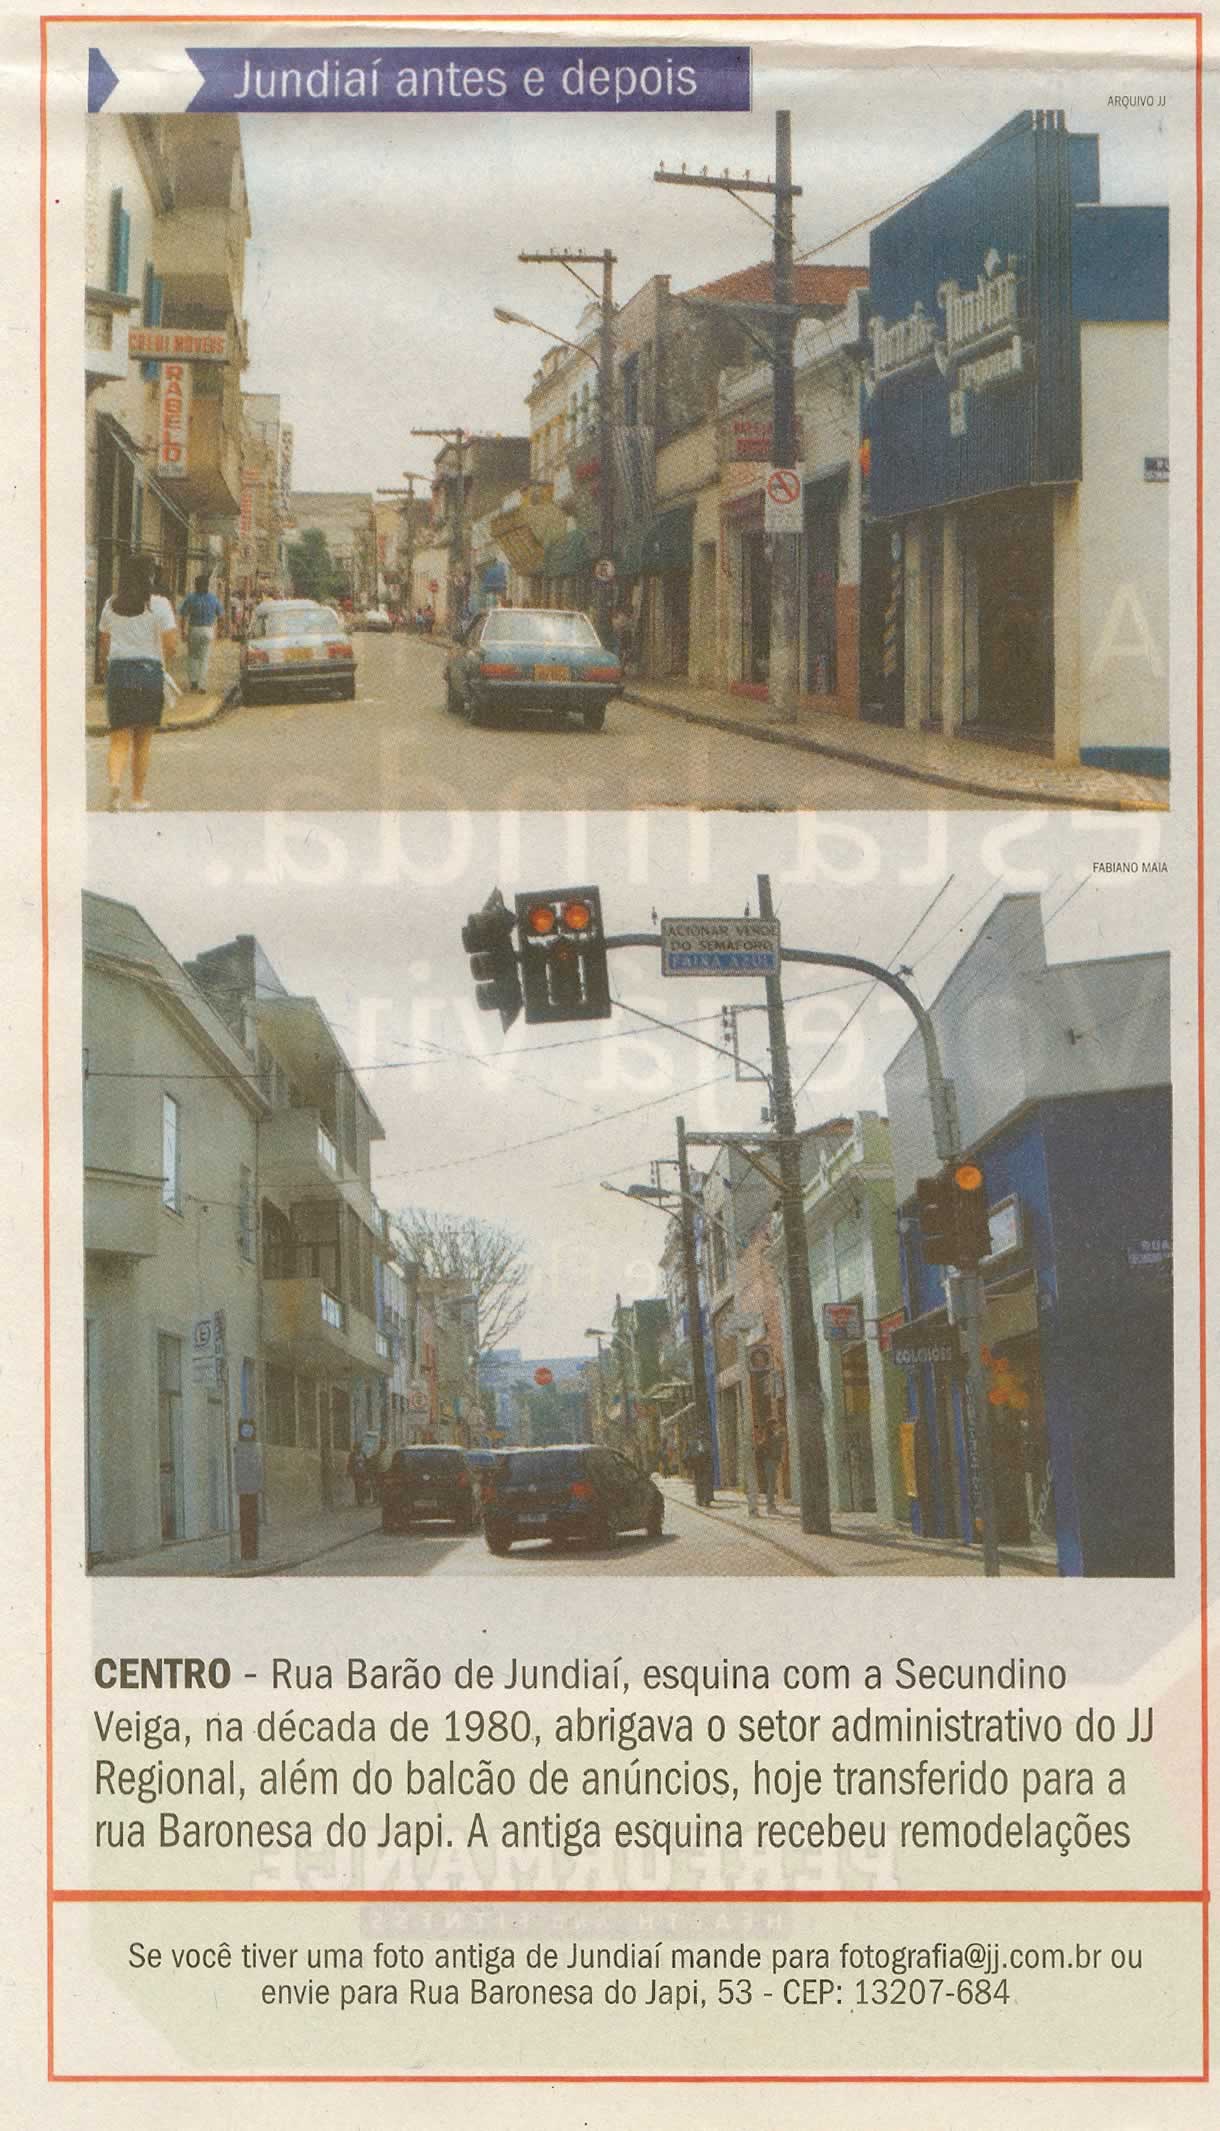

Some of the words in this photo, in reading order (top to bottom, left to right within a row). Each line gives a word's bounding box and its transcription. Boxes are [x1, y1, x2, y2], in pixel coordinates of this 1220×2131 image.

[233, 58, 381, 98] Jundiaí
[397, 62, 506, 97] antes
[523, 68, 545, 97] e
[562, 58, 697, 104] depois
[1107, 95, 1153, 108] ARQUIVO
[1157, 95, 1166, 107] JJ
[1092, 862, 1138, 874] FABIANO
[1141, 862, 1168, 874] MAIA
[670, 941, 692, 951] DO
[95, 1658, 230, 1689] CENTRO
[273, 1659, 332, 1690] Rua
[349, 1658, 441, 1690] Barão
[455, 1659, 494, 1689] de
[505, 1657, 629, 1695] Jundiaí,
[644, 1659, 769, 1697] esquina
[784, 1665, 850, 1690] com
[865, 1666, 882, 1690] a
[896, 1658, 1066, 1690] Secundino
[94, 1711, 191, 1750] Veiga,
[207, 1717, 243, 1743] na
[257, 1709, 376, 1743] década
[391, 1710, 429, 1743] de
[446, 1710, 541, 1748] 1980,
[556, 1708, 692, 1750] abrigava
[708, 1716, 726, 1743] o
[739, 1710, 821, 1743] setor
[832, 1708, 1062, 1743] administrativo
[1076, 1708, 1115, 1743] do
[1127, 1708, 1153, 1743] JJ
[97, 1760, 245, 1803] Regional,
[260, 1759, 337, 1795] além
[353, 1760, 392, 1795] do
[407, 1760, 515, 1795] balcão
[530, 1760, 568, 1795] de
[583, 1758, 738, 1801] anúncios,
[754, 1760, 822, 1803] hoje
[834, 1760, 1008, 1795] transferido
[1023, 1768, 1094, 1803] para
[1109, 1769, 1125, 1795] a
[96, 1820, 145, 1848] rua
[160, 1813, 312, 1848] Baronesa
[326, 1813, 366, 1848] do
[378, 1813, 453, 1856] Japi.
[468, 1813, 488, 1848] A
[501, 1813, 601, 1856] antiga
[615, 1814, 743, 1856] esquina
[757, 1813, 886, 1848] recebeu
[901, 1813, 1131, 1857] remodelações
[129, 1943, 162, 1969] Se
[172, 1942, 232, 1969] você
[242, 1943, 298, 1969] tiver
[307, 1949, 363, 1969] uma
[374, 1943, 424, 1969] foto
[435, 1943, 515, 1975] antiga
[526, 1943, 558, 1969] de
[567, 1942, 663, 1969] Jundiaí
[671, 1943, 761, 1969] mande
[772, 1949, 829, 1975] para
[840, 1943, 1101, 1975] fotografia@jj.com.br
[1111, 1949, 1142, 1969] ou
[261, 1979, 329, 2005] envie
[341, 1984, 398, 2010] para
[410, 1980, 459, 2005] Rua
[471, 1979, 593, 2005] Baronesa
[604, 1979, 637, 2005] do
[646, 1980, 706, 2010] Japi,
[718, 1979, 752, 2005] 53
[783, 1979, 842, 2005] CEP:
[856, 1979, 1010, 2005] 13207-684
